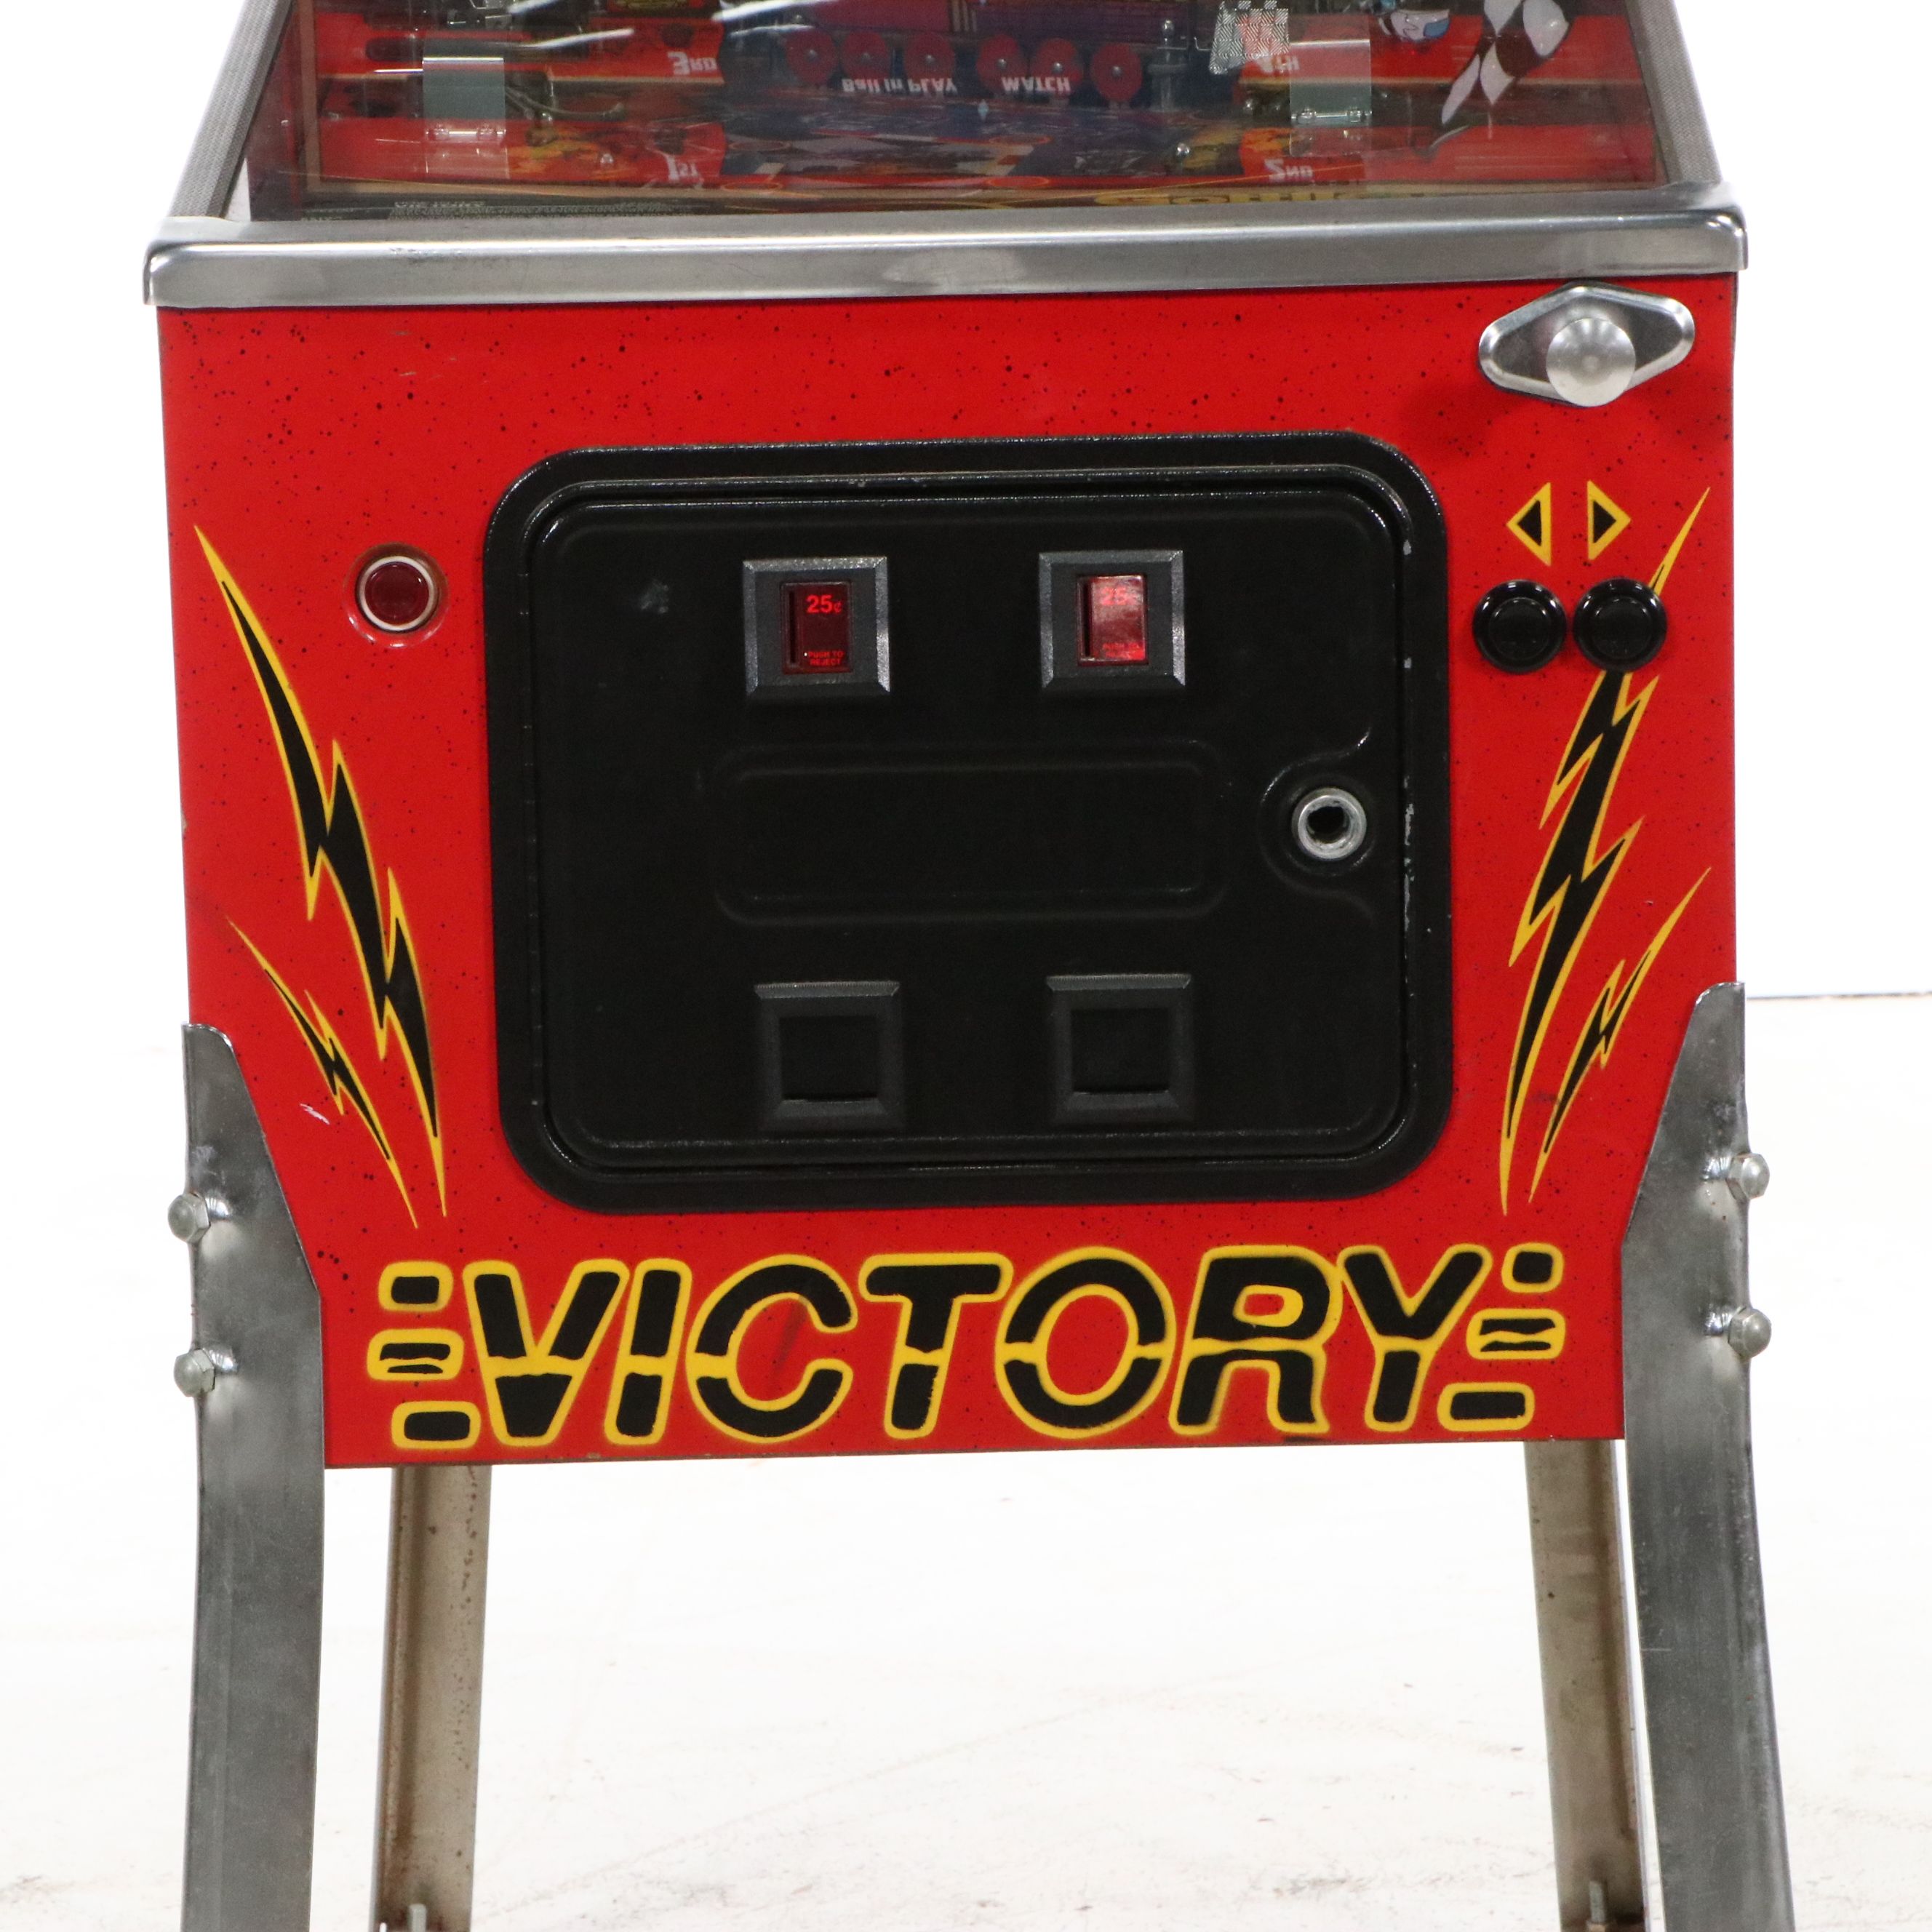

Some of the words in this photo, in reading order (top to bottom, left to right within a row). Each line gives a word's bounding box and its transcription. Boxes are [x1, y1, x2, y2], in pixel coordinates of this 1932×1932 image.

[805, 594, 842, 615] 25¢
[832, 650, 844, 658] TO
[463, 1244, 1490, 1448] VICTORY
